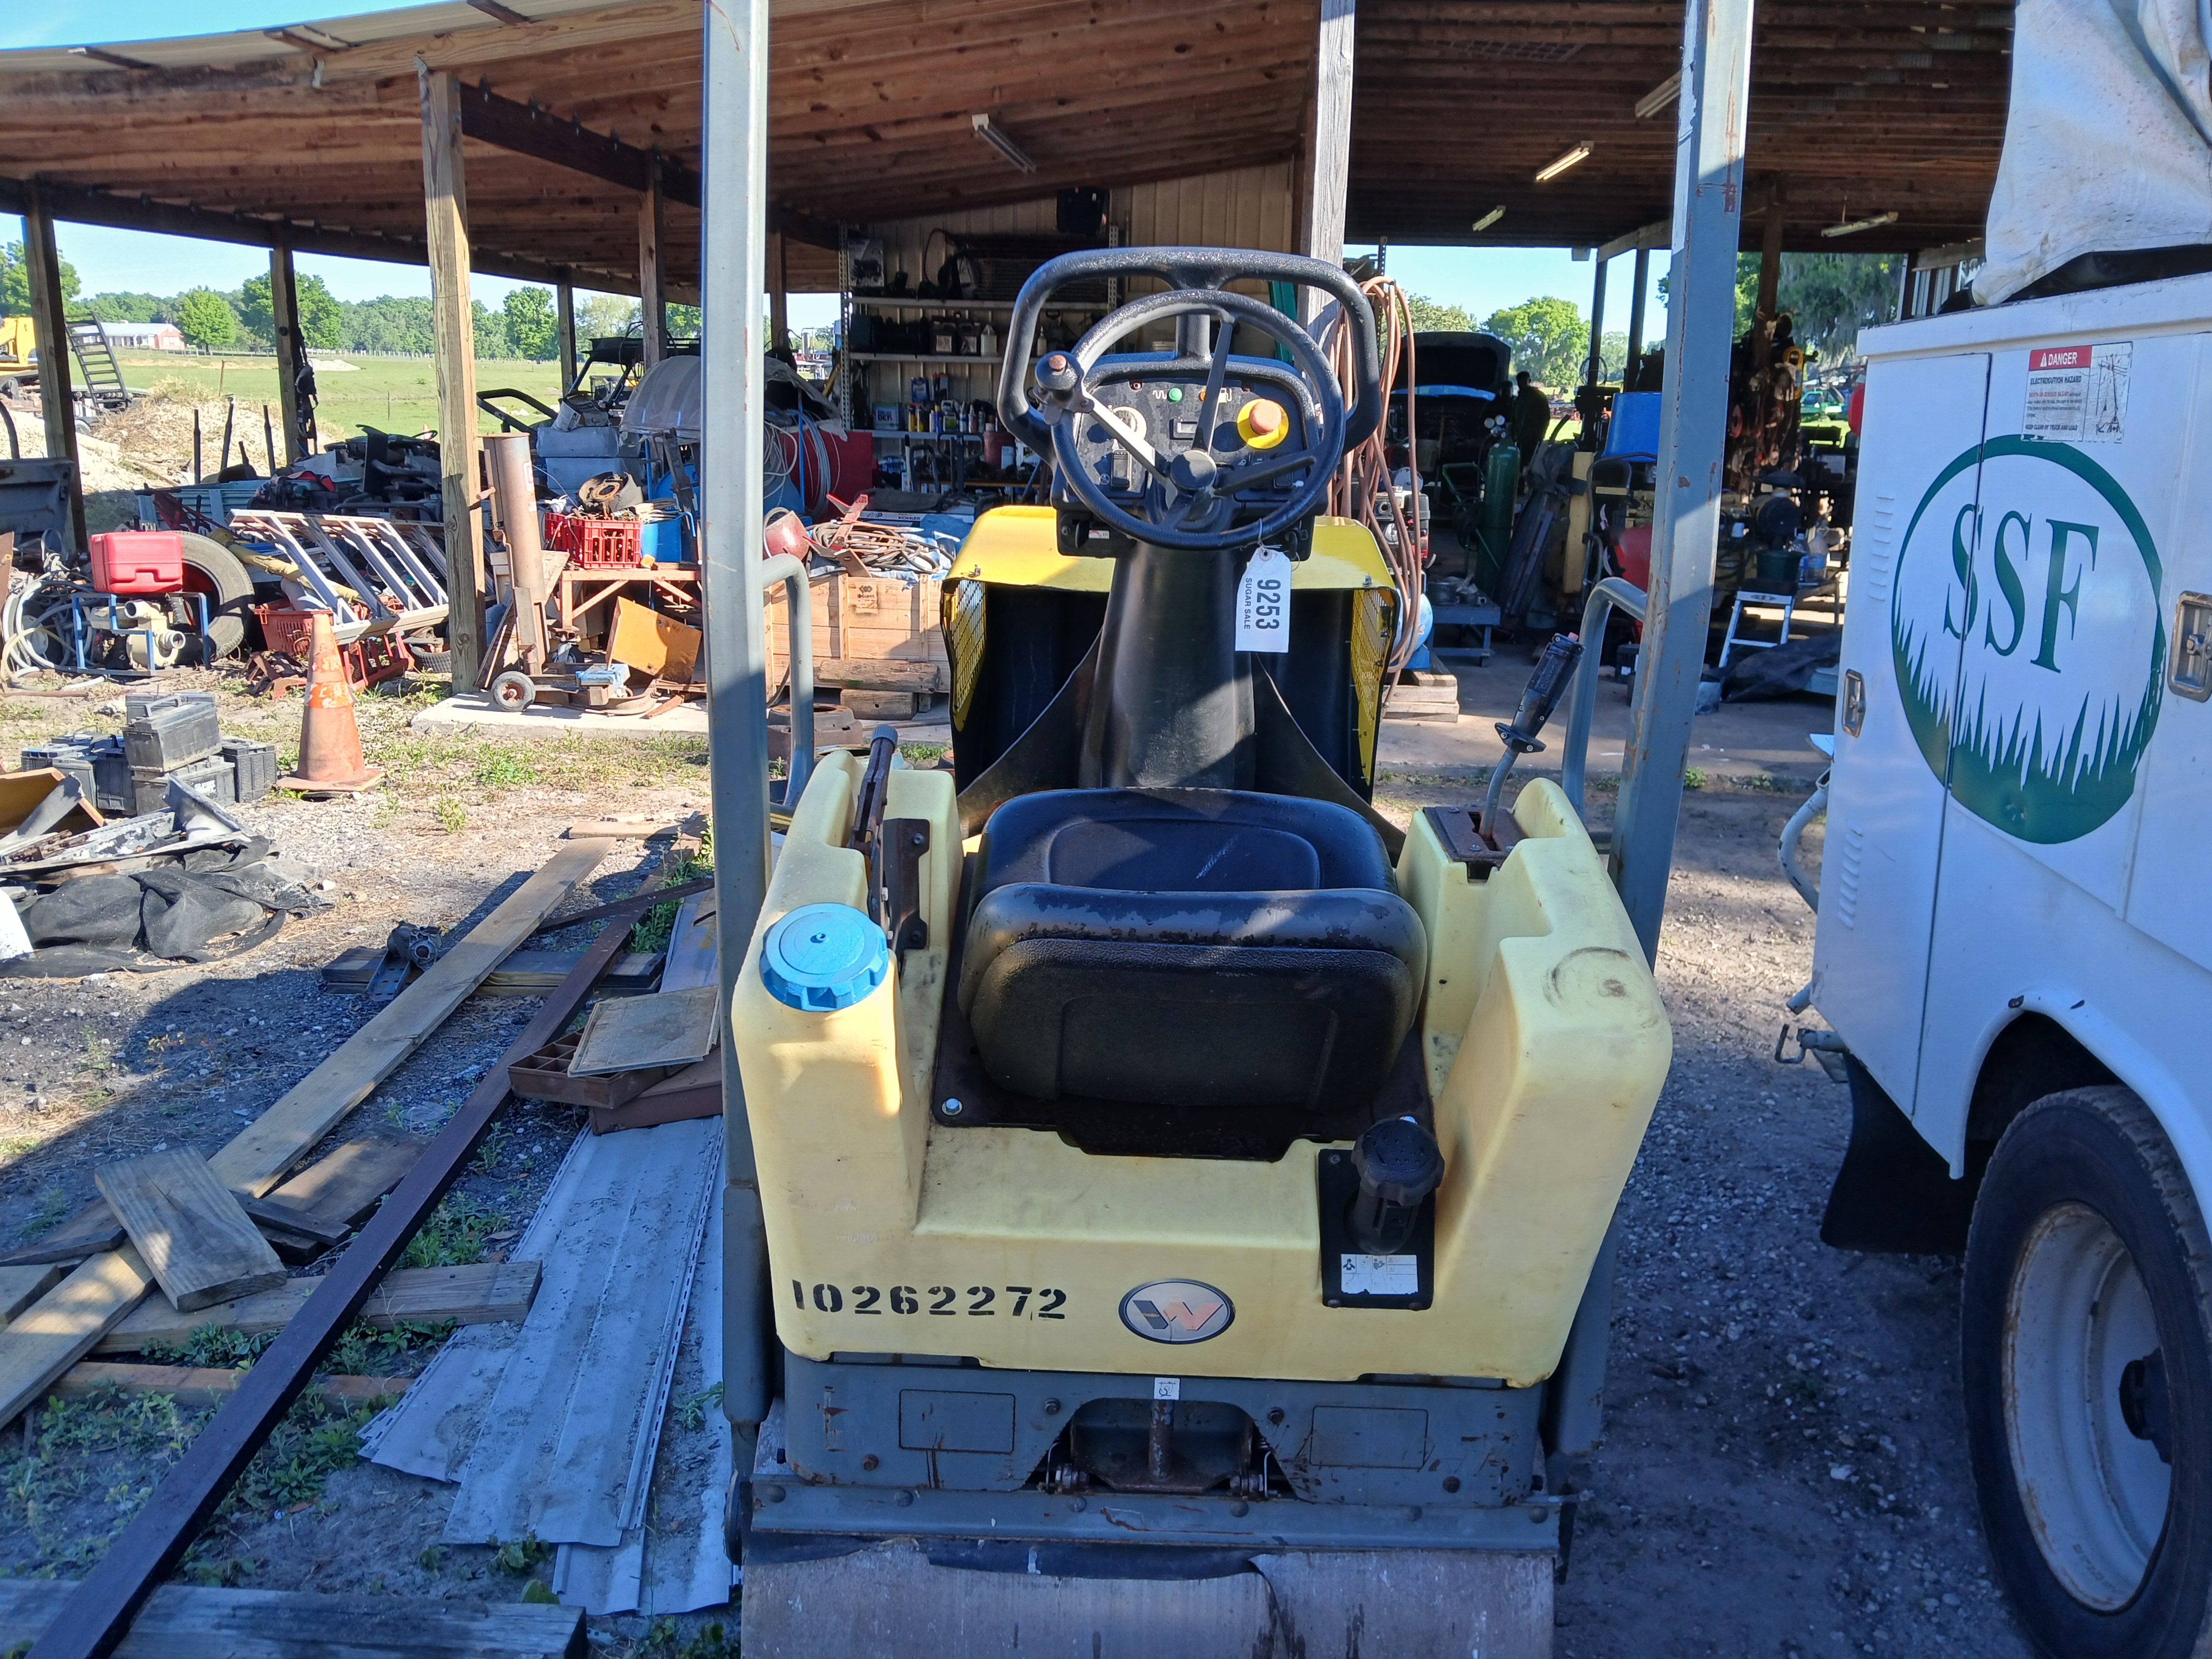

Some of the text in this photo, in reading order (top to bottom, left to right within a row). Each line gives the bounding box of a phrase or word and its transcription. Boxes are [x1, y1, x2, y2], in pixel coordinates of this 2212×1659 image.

[2048, 351, 2078, 366] DANGER
[2030, 377, 2063, 385] ELECTROCUTION
[1255, 579, 1281, 630] 9253
[1943, 503, 2099, 674] SSF
[792, 1279, 1067, 1320] 10262272
